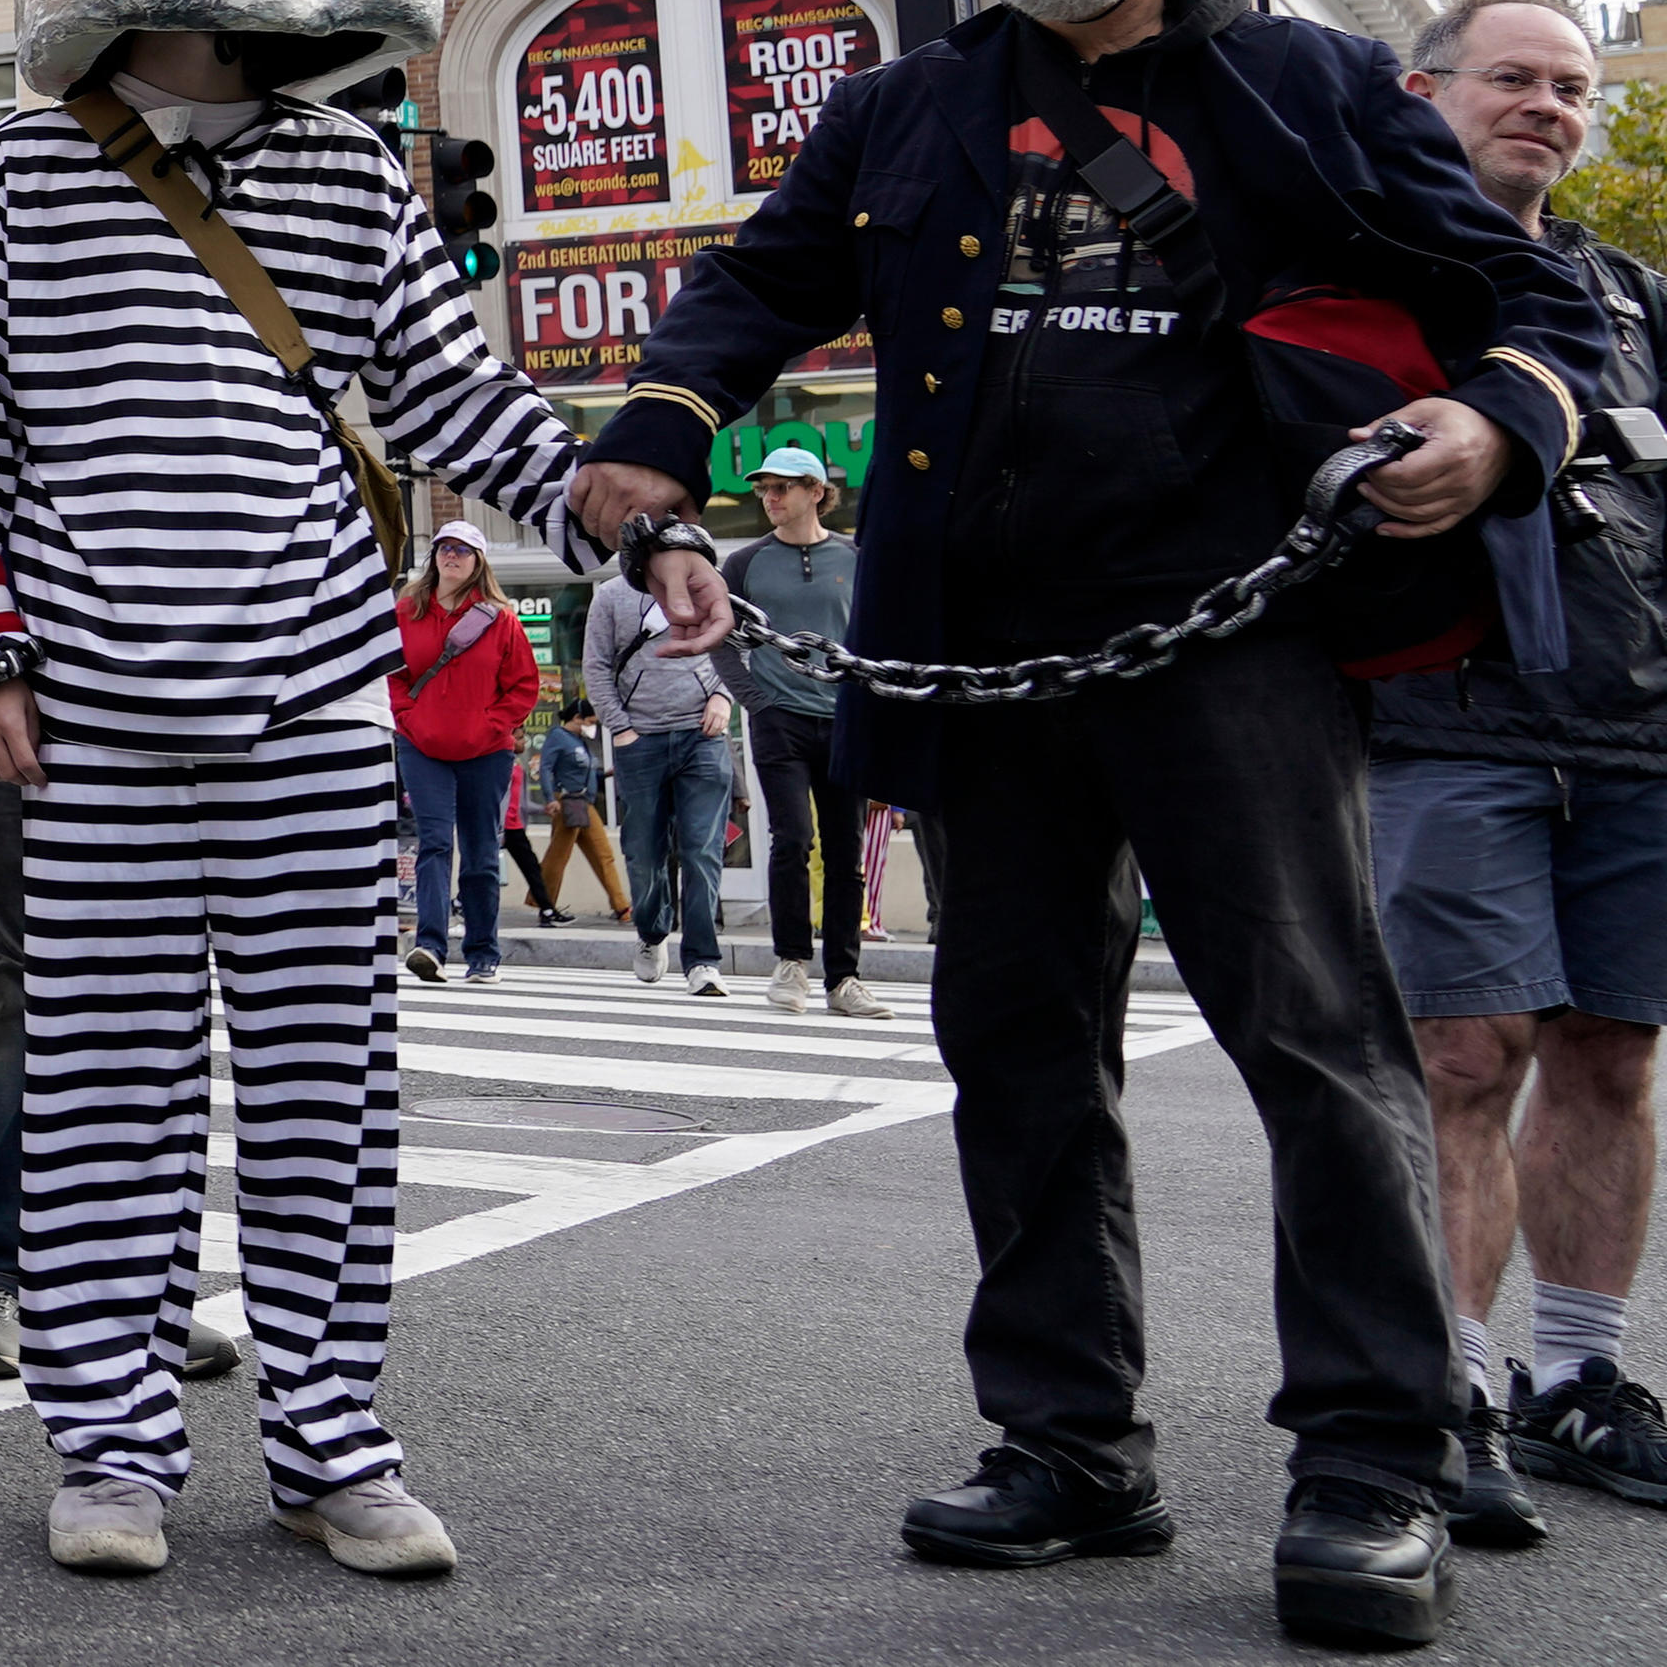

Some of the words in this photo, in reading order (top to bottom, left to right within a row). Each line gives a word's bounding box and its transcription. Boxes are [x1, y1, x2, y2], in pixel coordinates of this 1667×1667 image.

[748, 30, 857, 77] ROOF
[524, 64, 655, 142] ~5,400
[532, 138, 607, 172] SQUARE
[610, 132, 656, 163] FEET
[748, 154, 785, 180] 202
[535, 172, 659, 197] wes@recondc.com
[517, 249, 546, 270] 2nd
[550, 243, 641, 268] GENERATION
[520, 270, 652, 342] FOR
[1043, 306, 1180, 335] FORGET
[524, 347, 593, 370] NEWLY
[600, 344, 642, 365] REN
